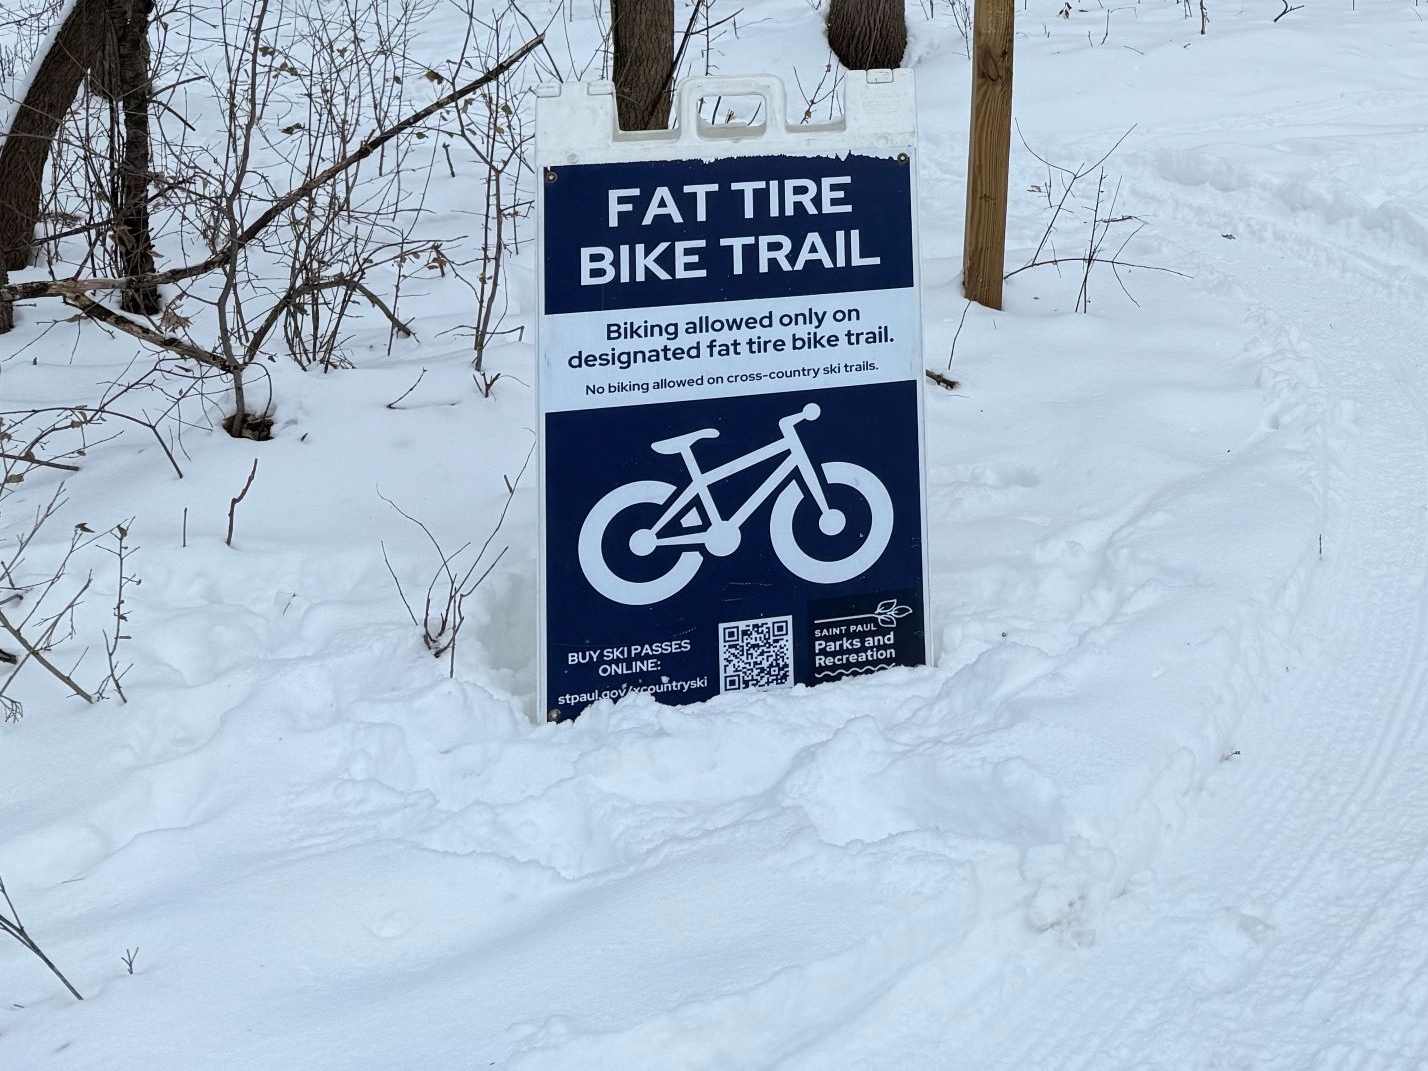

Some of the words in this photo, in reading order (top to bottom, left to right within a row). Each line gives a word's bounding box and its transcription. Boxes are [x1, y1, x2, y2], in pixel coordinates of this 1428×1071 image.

[608, 183, 719, 227] FAT
[730, 175, 853, 219] TIRE
[580, 239, 707, 286] BIKE
[719, 229, 881, 275] TRAIL
[606, 319, 679, 341] Biking
[685, 311, 773, 335] allowed
[779, 307, 828, 329] only
[832, 308, 861, 323] on
[567, 340, 701, 369] designated
[706, 338, 742, 358] fat
[746, 335, 786, 354] tire
[791, 331, 840, 351] bike
[845, 325, 894, 346] trail.
[585, 384, 605, 396] No
[608, 382, 650, 394] biking
[652, 375, 704, 390] allowed
[707, 375, 724, 385] on
[727, 367, 820, 383] cross-country
[823, 363, 841, 375] ski
[844, 360, 879, 373] trails.
[814, 626, 847, 637] SAINT
[849, 623, 877, 633] PAUL
[815, 637, 861, 654] Parks
[864, 631, 895, 647] and
[568, 649, 601, 665] BUY
[603, 646, 628, 661] SKI
[631, 639, 691, 657] PASSES
[815, 648, 896, 668] Recreation
[598, 659, 662, 677] ONLINE:
